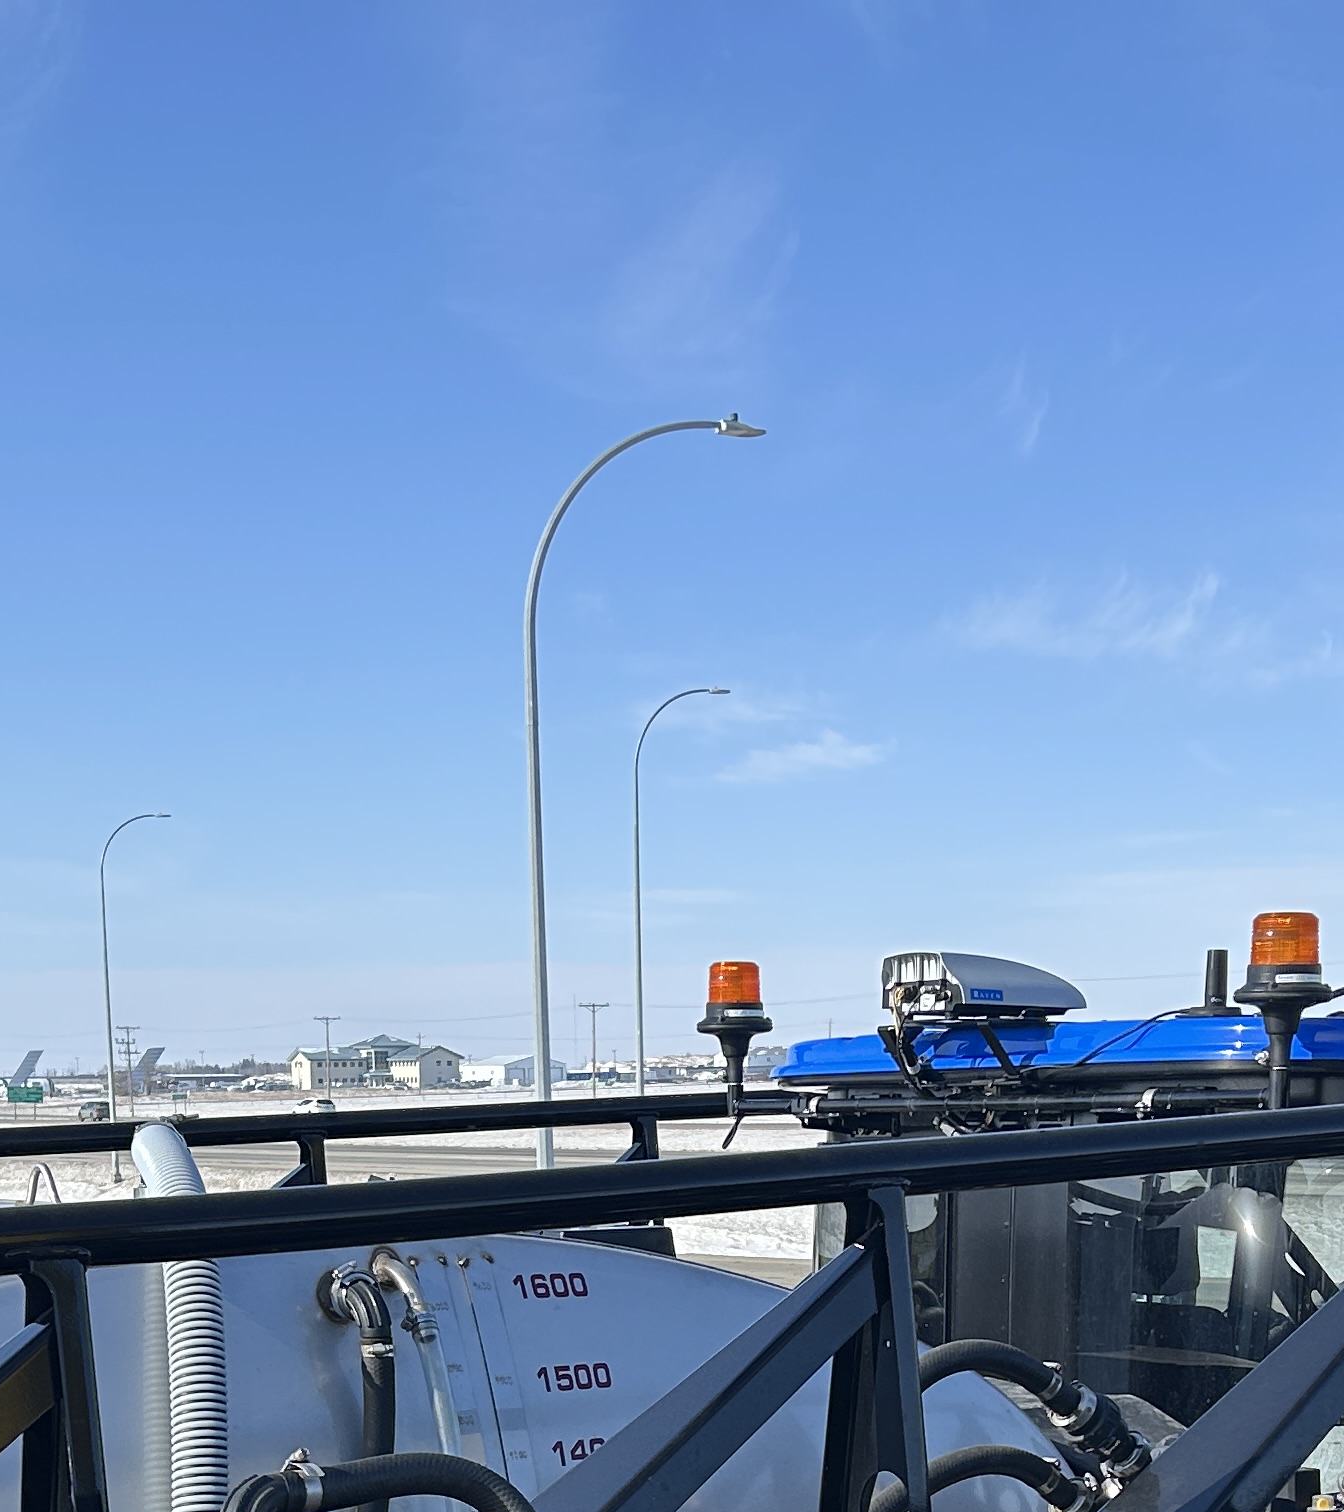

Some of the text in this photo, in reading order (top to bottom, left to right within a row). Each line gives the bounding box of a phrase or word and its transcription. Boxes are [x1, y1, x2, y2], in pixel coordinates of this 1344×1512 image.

[512, 1272, 589, 1299] 1600
[536, 1362, 613, 1393] 1500
[552, 1437, 606, 1467] 140
